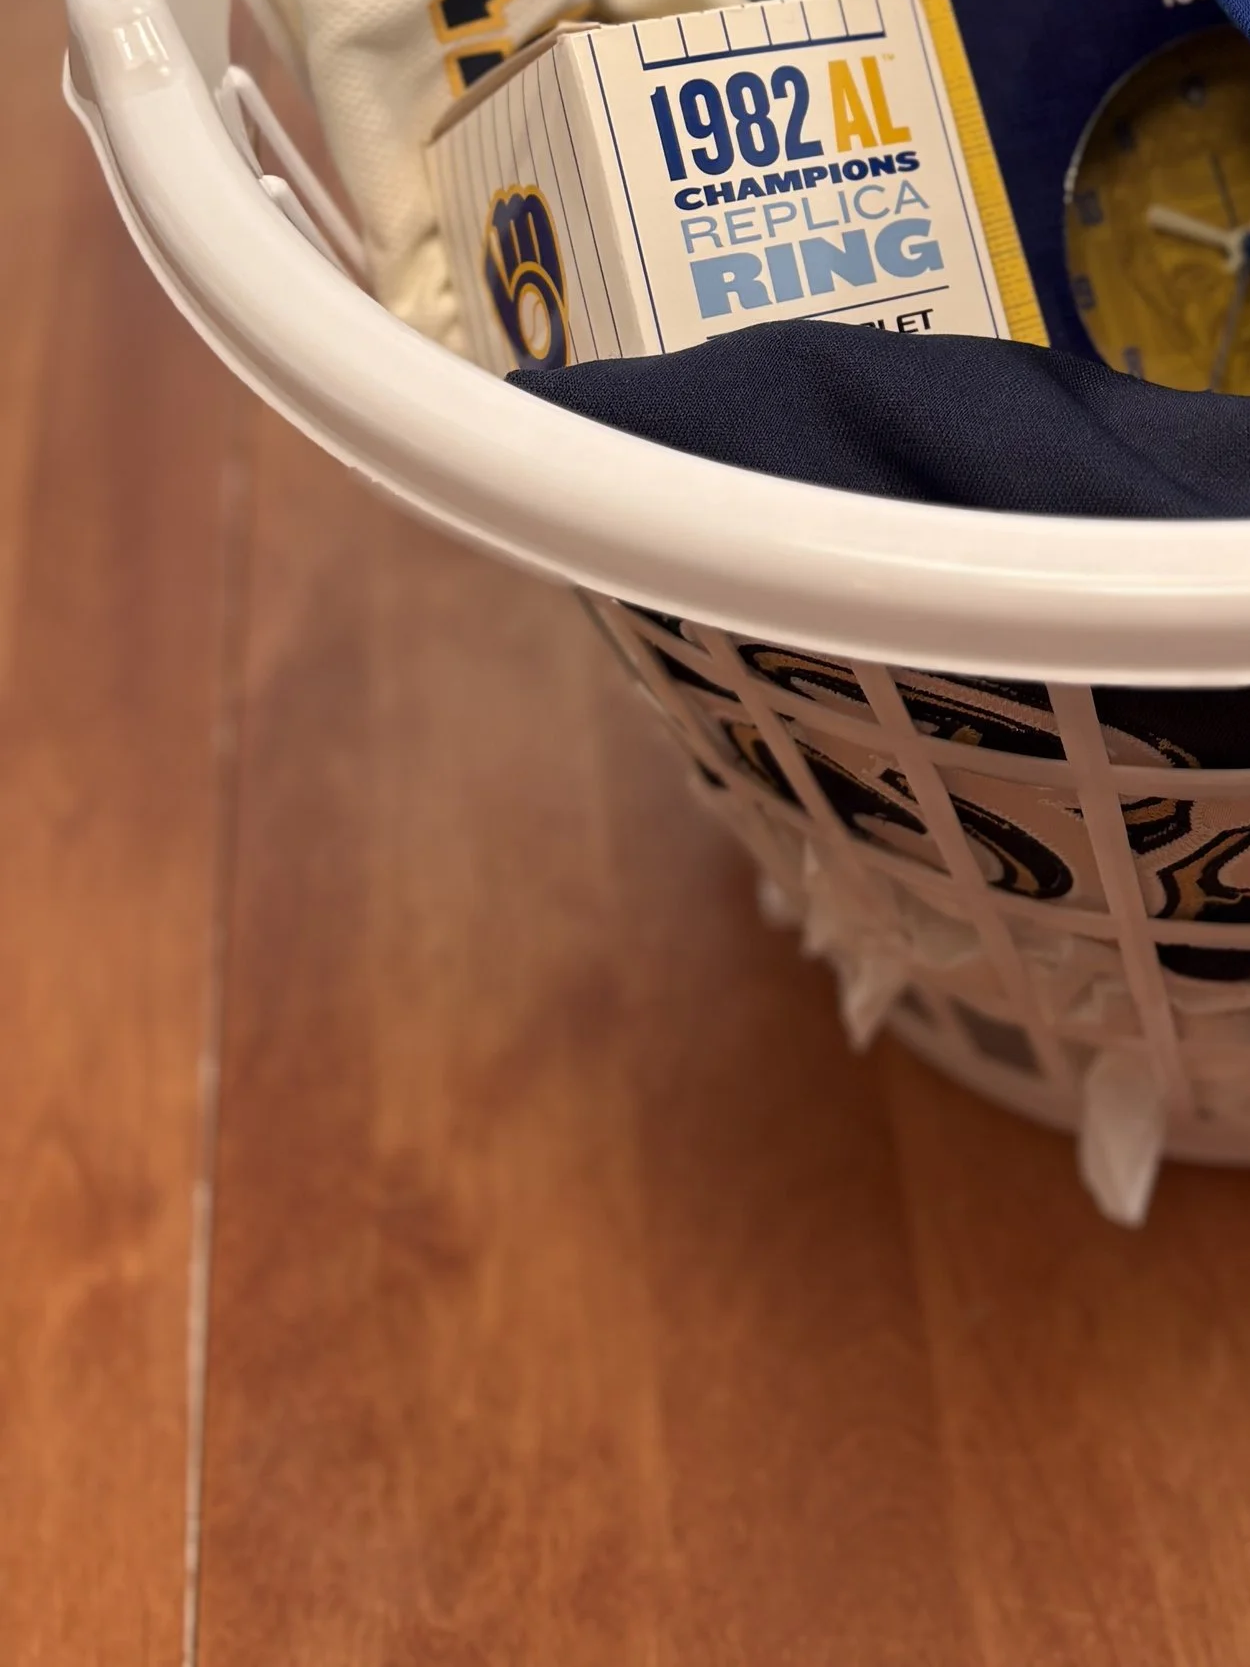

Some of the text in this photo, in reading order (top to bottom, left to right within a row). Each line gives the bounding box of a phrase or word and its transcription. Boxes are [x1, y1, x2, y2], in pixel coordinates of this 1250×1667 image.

[650, 65, 824, 182] 1982
[828, 56, 913, 154] AL
[674, 150, 921, 211] CHAMPIONS
[680, 179, 931, 254] REPLICA
[689, 218, 945, 319] RING
